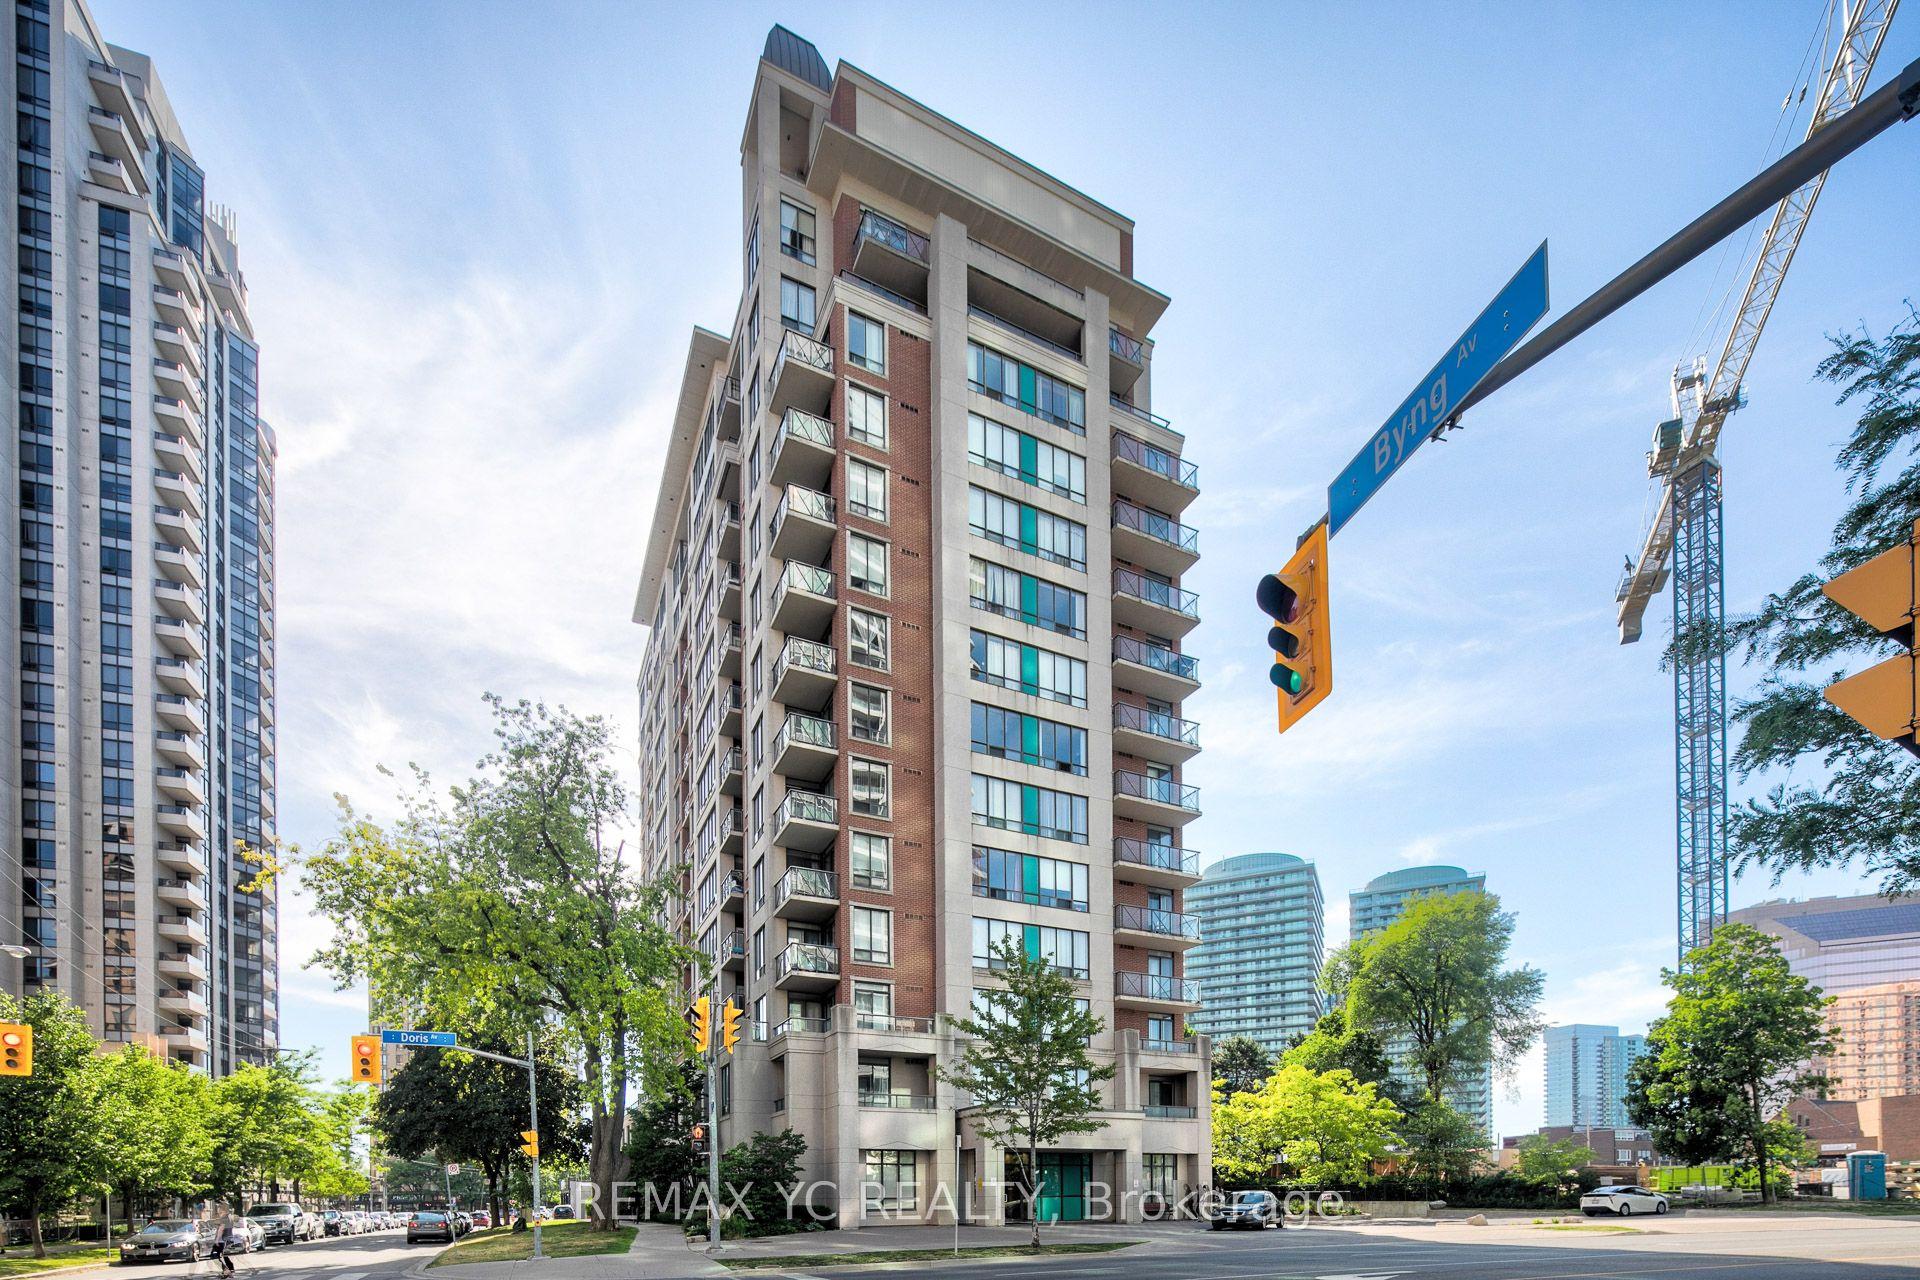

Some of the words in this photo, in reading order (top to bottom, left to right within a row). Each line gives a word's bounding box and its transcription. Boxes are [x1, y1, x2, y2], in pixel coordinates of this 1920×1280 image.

[1373, 372, 1447, 474] Byng
[1456, 333, 1478, 369] Av
[401, 1033, 429, 1043] Doris
